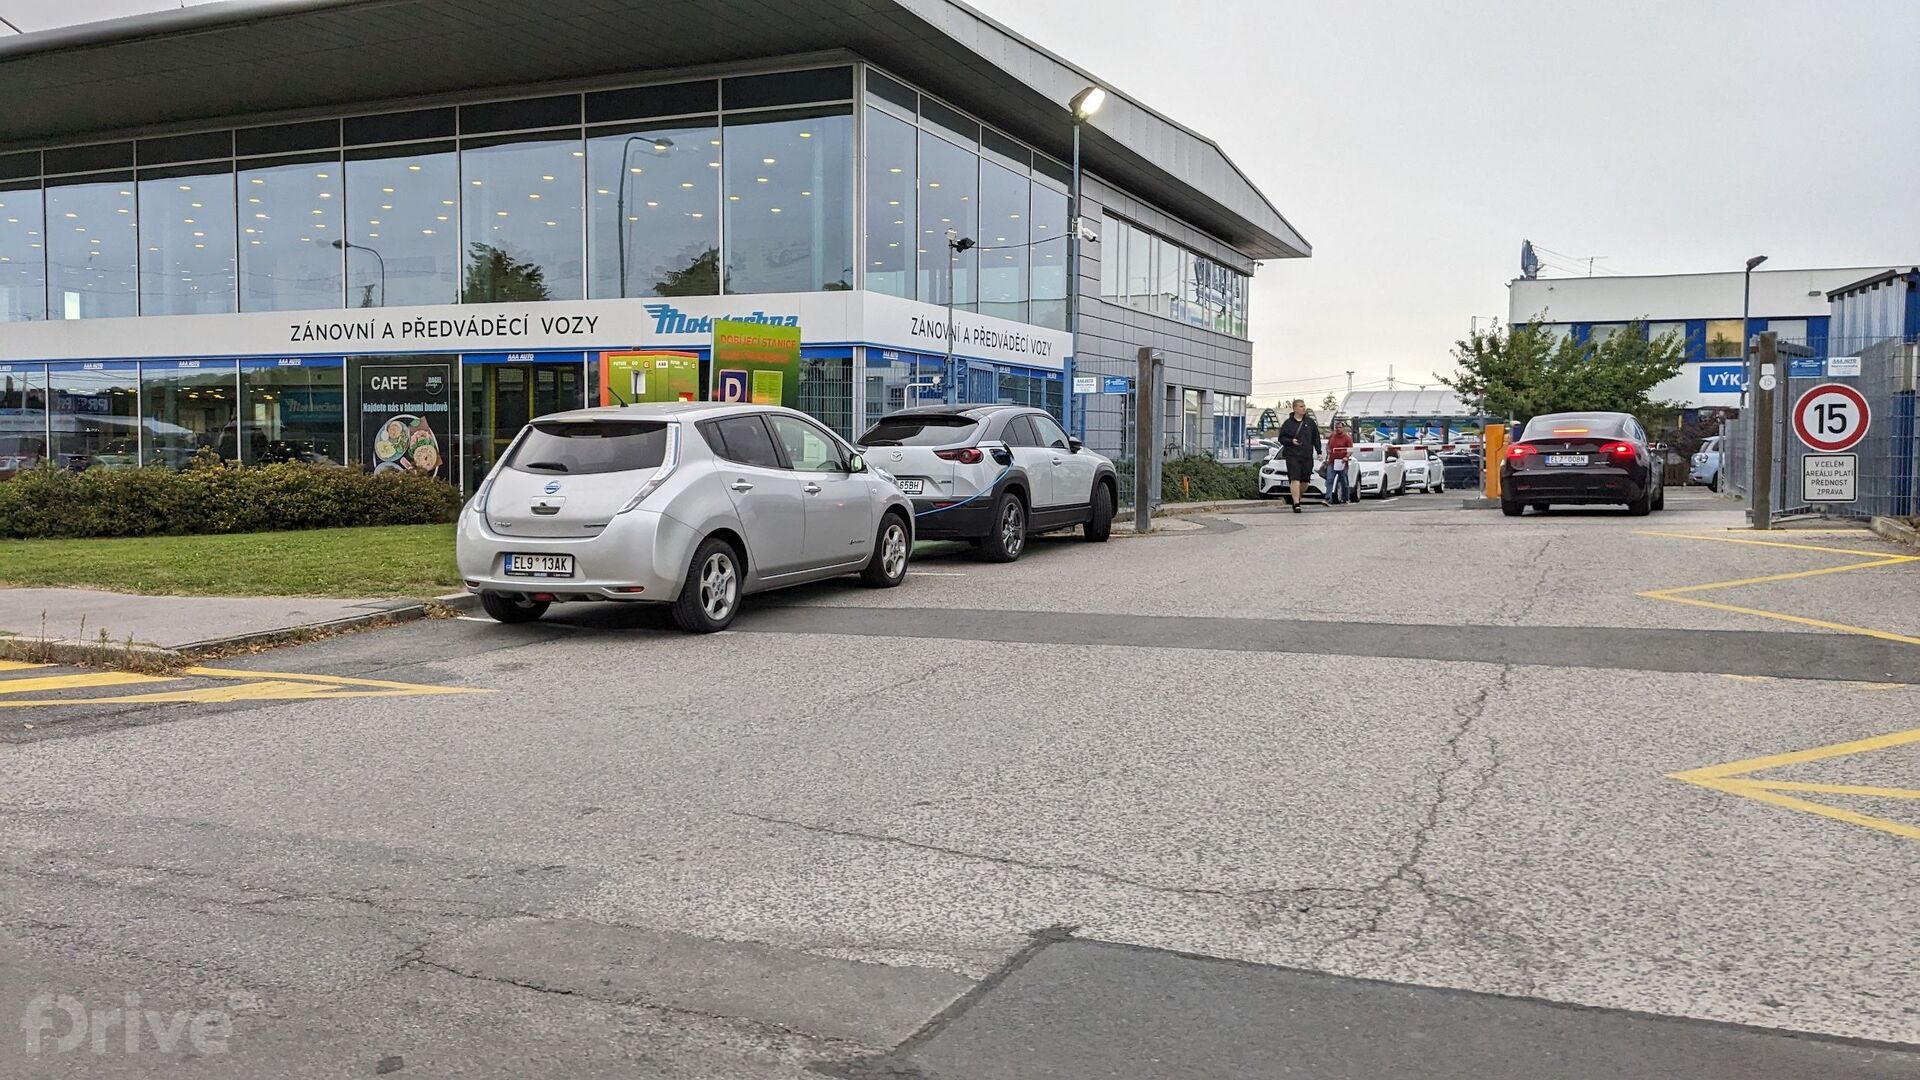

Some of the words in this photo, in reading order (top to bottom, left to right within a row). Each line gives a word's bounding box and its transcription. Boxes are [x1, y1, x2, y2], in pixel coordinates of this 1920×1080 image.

[290, 318, 375, 341] ZÁNOVNÍ
[381, 321, 395, 339] A
[402, 313, 529, 338] PŘEDVÁDĚCÍ
[540, 315, 599, 335] VOZY
[761, 337, 798, 350] STANICE
[962, 326, 971, 344] A
[973, 325, 1030, 353] PŘEDVÁDĚCÍ
[1030, 339, 1053, 357] VOZY
[371, 376, 408, 391] CAFE
[363, 402, 387, 413] Najdete
[387, 402, 399, 412] nás
[1813, 403, 1847, 434] 15
[1820, 459, 1845, 468] CELÉM
[1806, 469, 1833, 477] AREÁLU
[1834, 469, 1854, 477] PLATÍ
[1811, 477, 1848, 486] PŘEDNOST
